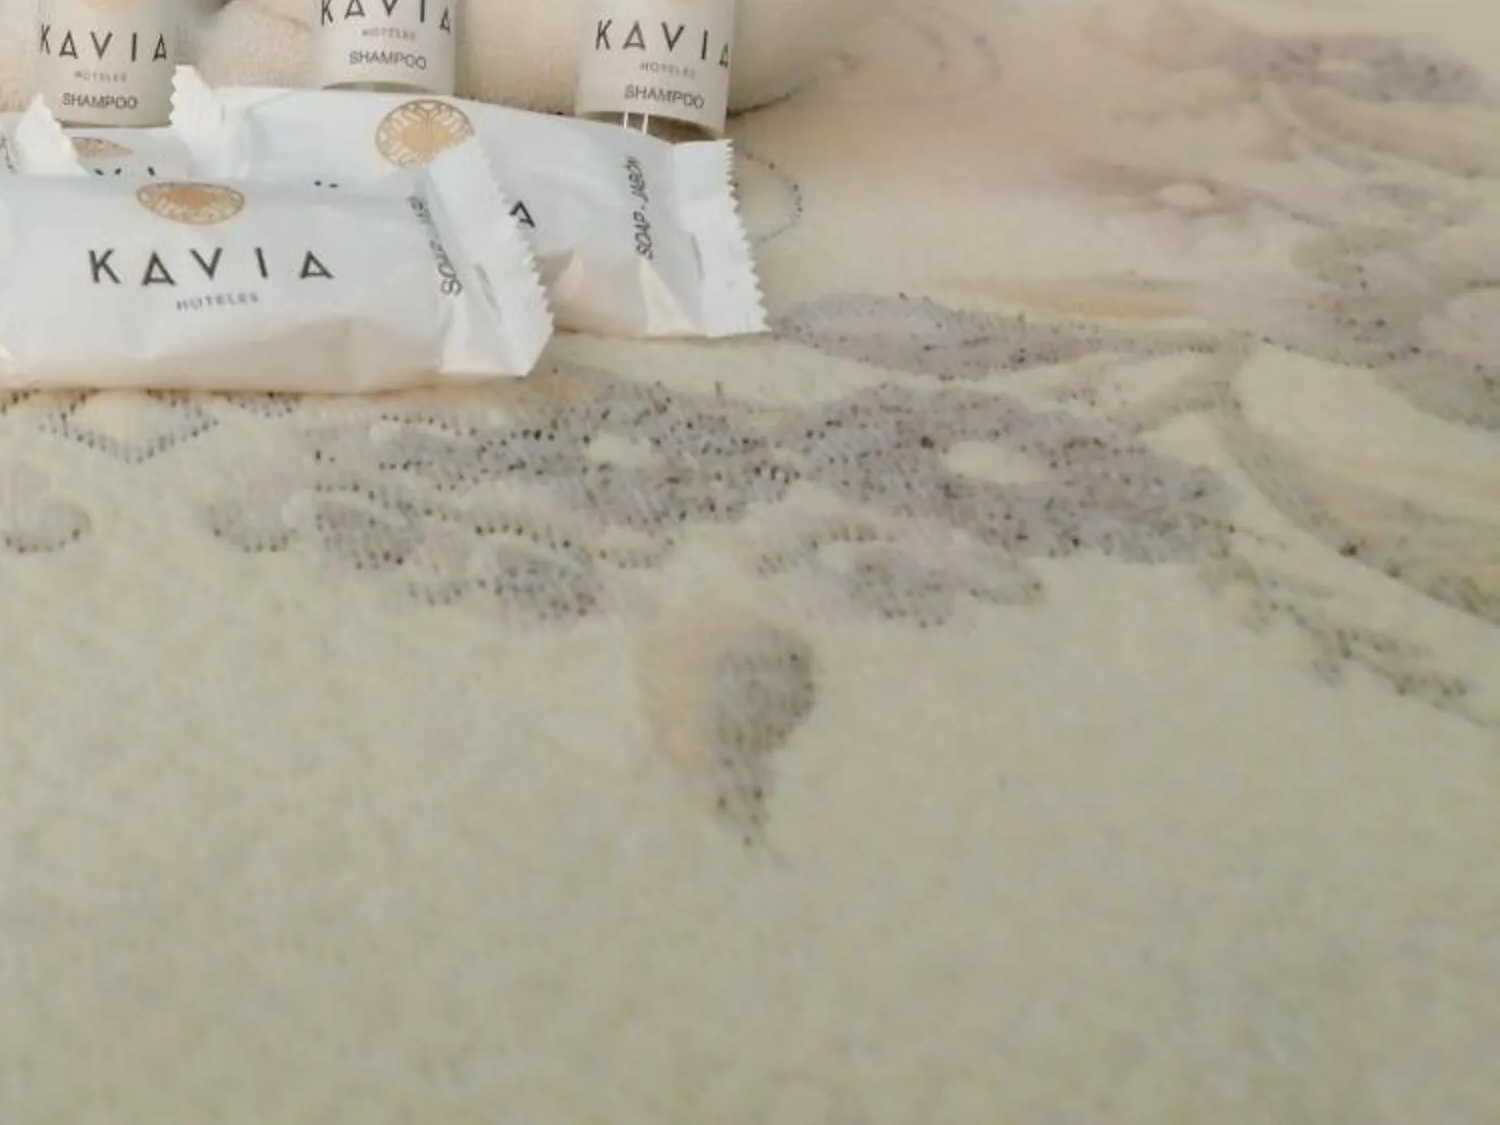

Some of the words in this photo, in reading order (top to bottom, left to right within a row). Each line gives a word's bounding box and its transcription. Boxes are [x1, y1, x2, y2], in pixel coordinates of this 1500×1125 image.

[40, 24, 168, 62] KAVIA
[595, 18, 729, 68] KAVIA
[350, 50, 427, 71] SHAMPOO
[62, 92, 138, 110] SHAMPOO
[624, 84, 705, 110] SHAMPOO
[87, 246, 335, 287] KAVIA
[175, 291, 260, 311] HOTELES
